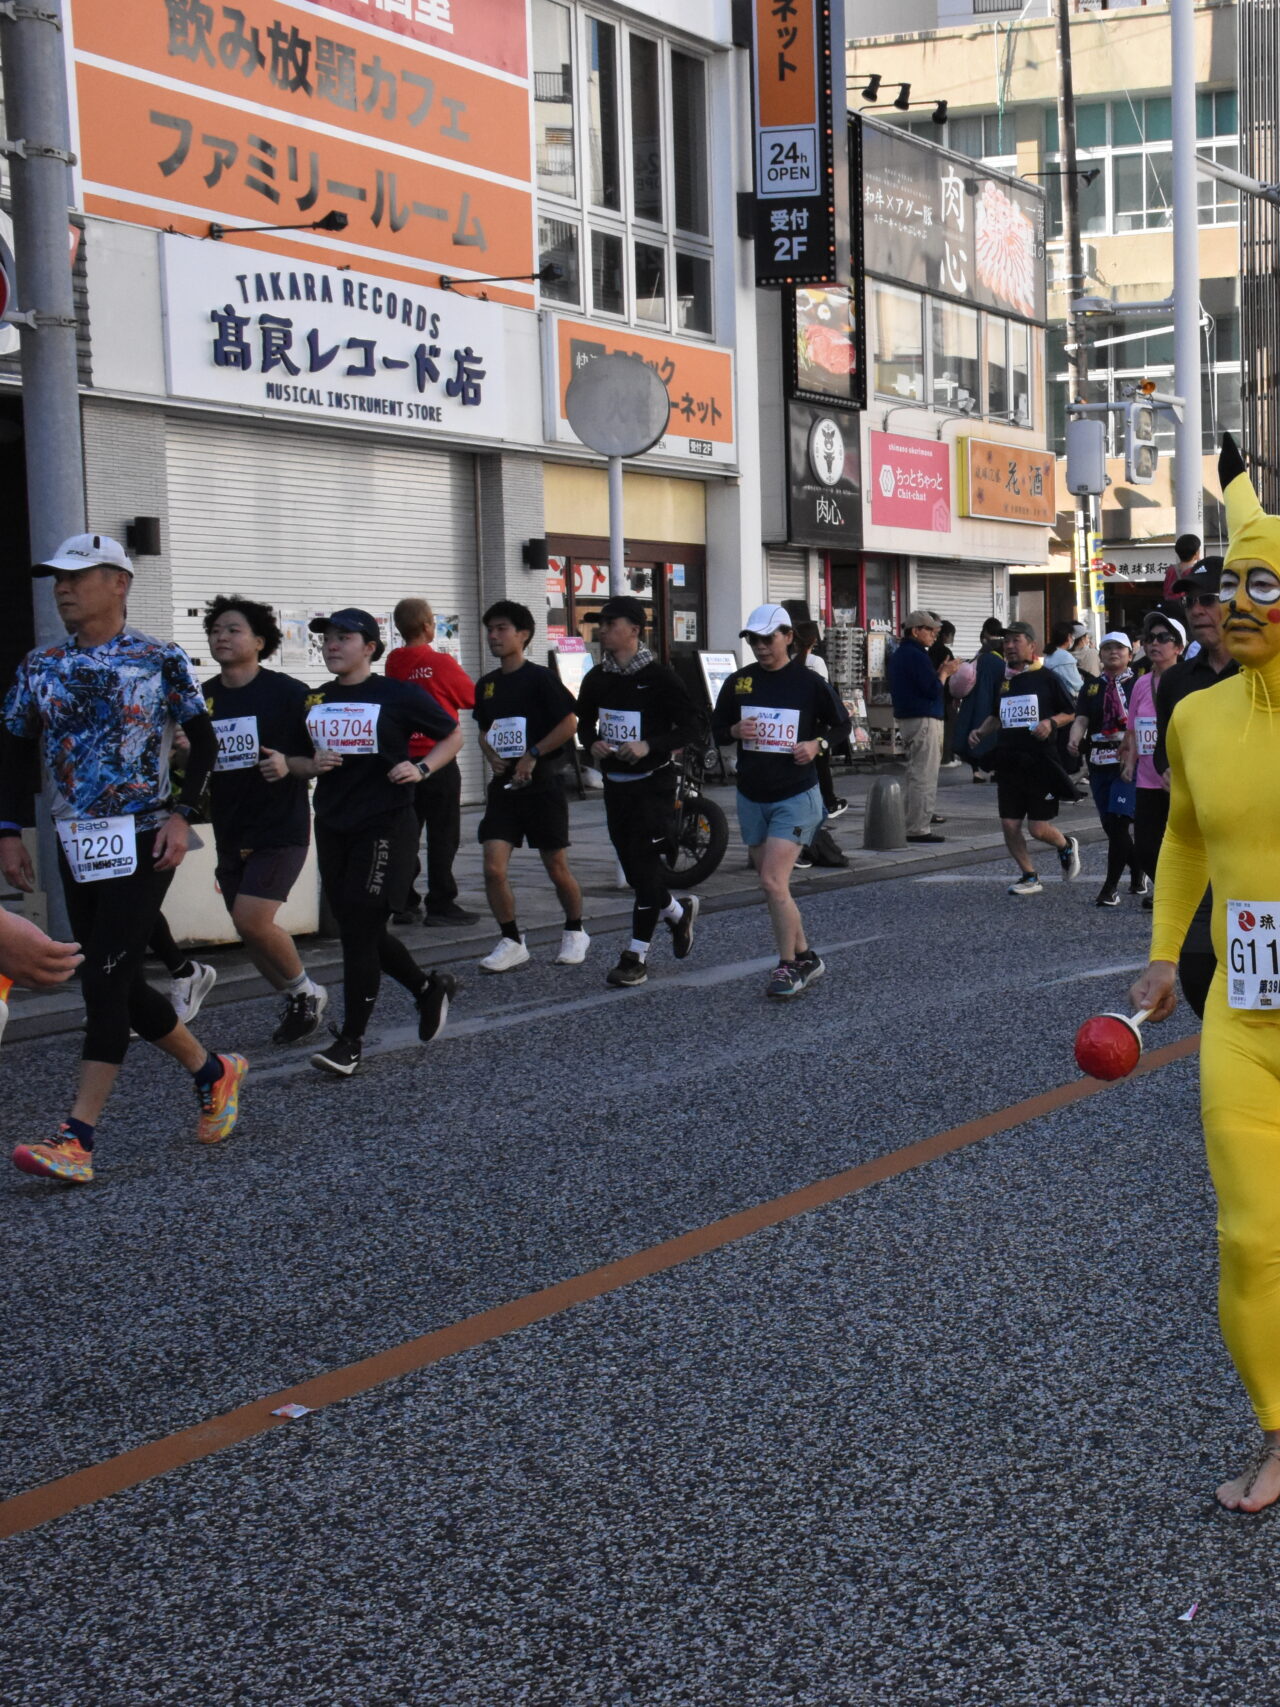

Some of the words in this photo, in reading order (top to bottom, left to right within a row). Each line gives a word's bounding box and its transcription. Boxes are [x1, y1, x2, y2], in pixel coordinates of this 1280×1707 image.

[166, 0, 470, 143] 飲み放題カフェ
[770, 141, 807, 166] 24h
[149, 110, 488, 252] ファミリールーム
[767, 165, 810, 182] OPEN
[770, 208, 809, 232] 受付
[774, 236, 808, 261] 2F
[236, 272, 332, 305] TAKARA
[344, 278, 442, 339] RECORDS
[266, 381, 324, 407] MUSICAL
[327, 390, 403, 418] INSTRUMENT
[406, 396, 443, 423] STORE
[896, 467, 944, 490] ちっとちゃっと
[816, 495, 842, 525] 肉心
[1119, 560, 1169, 575] 琉球銀行
[308, 719, 373, 738] H13704
[78, 820, 109, 832] sato
[369, 839, 389, 896] KELME
